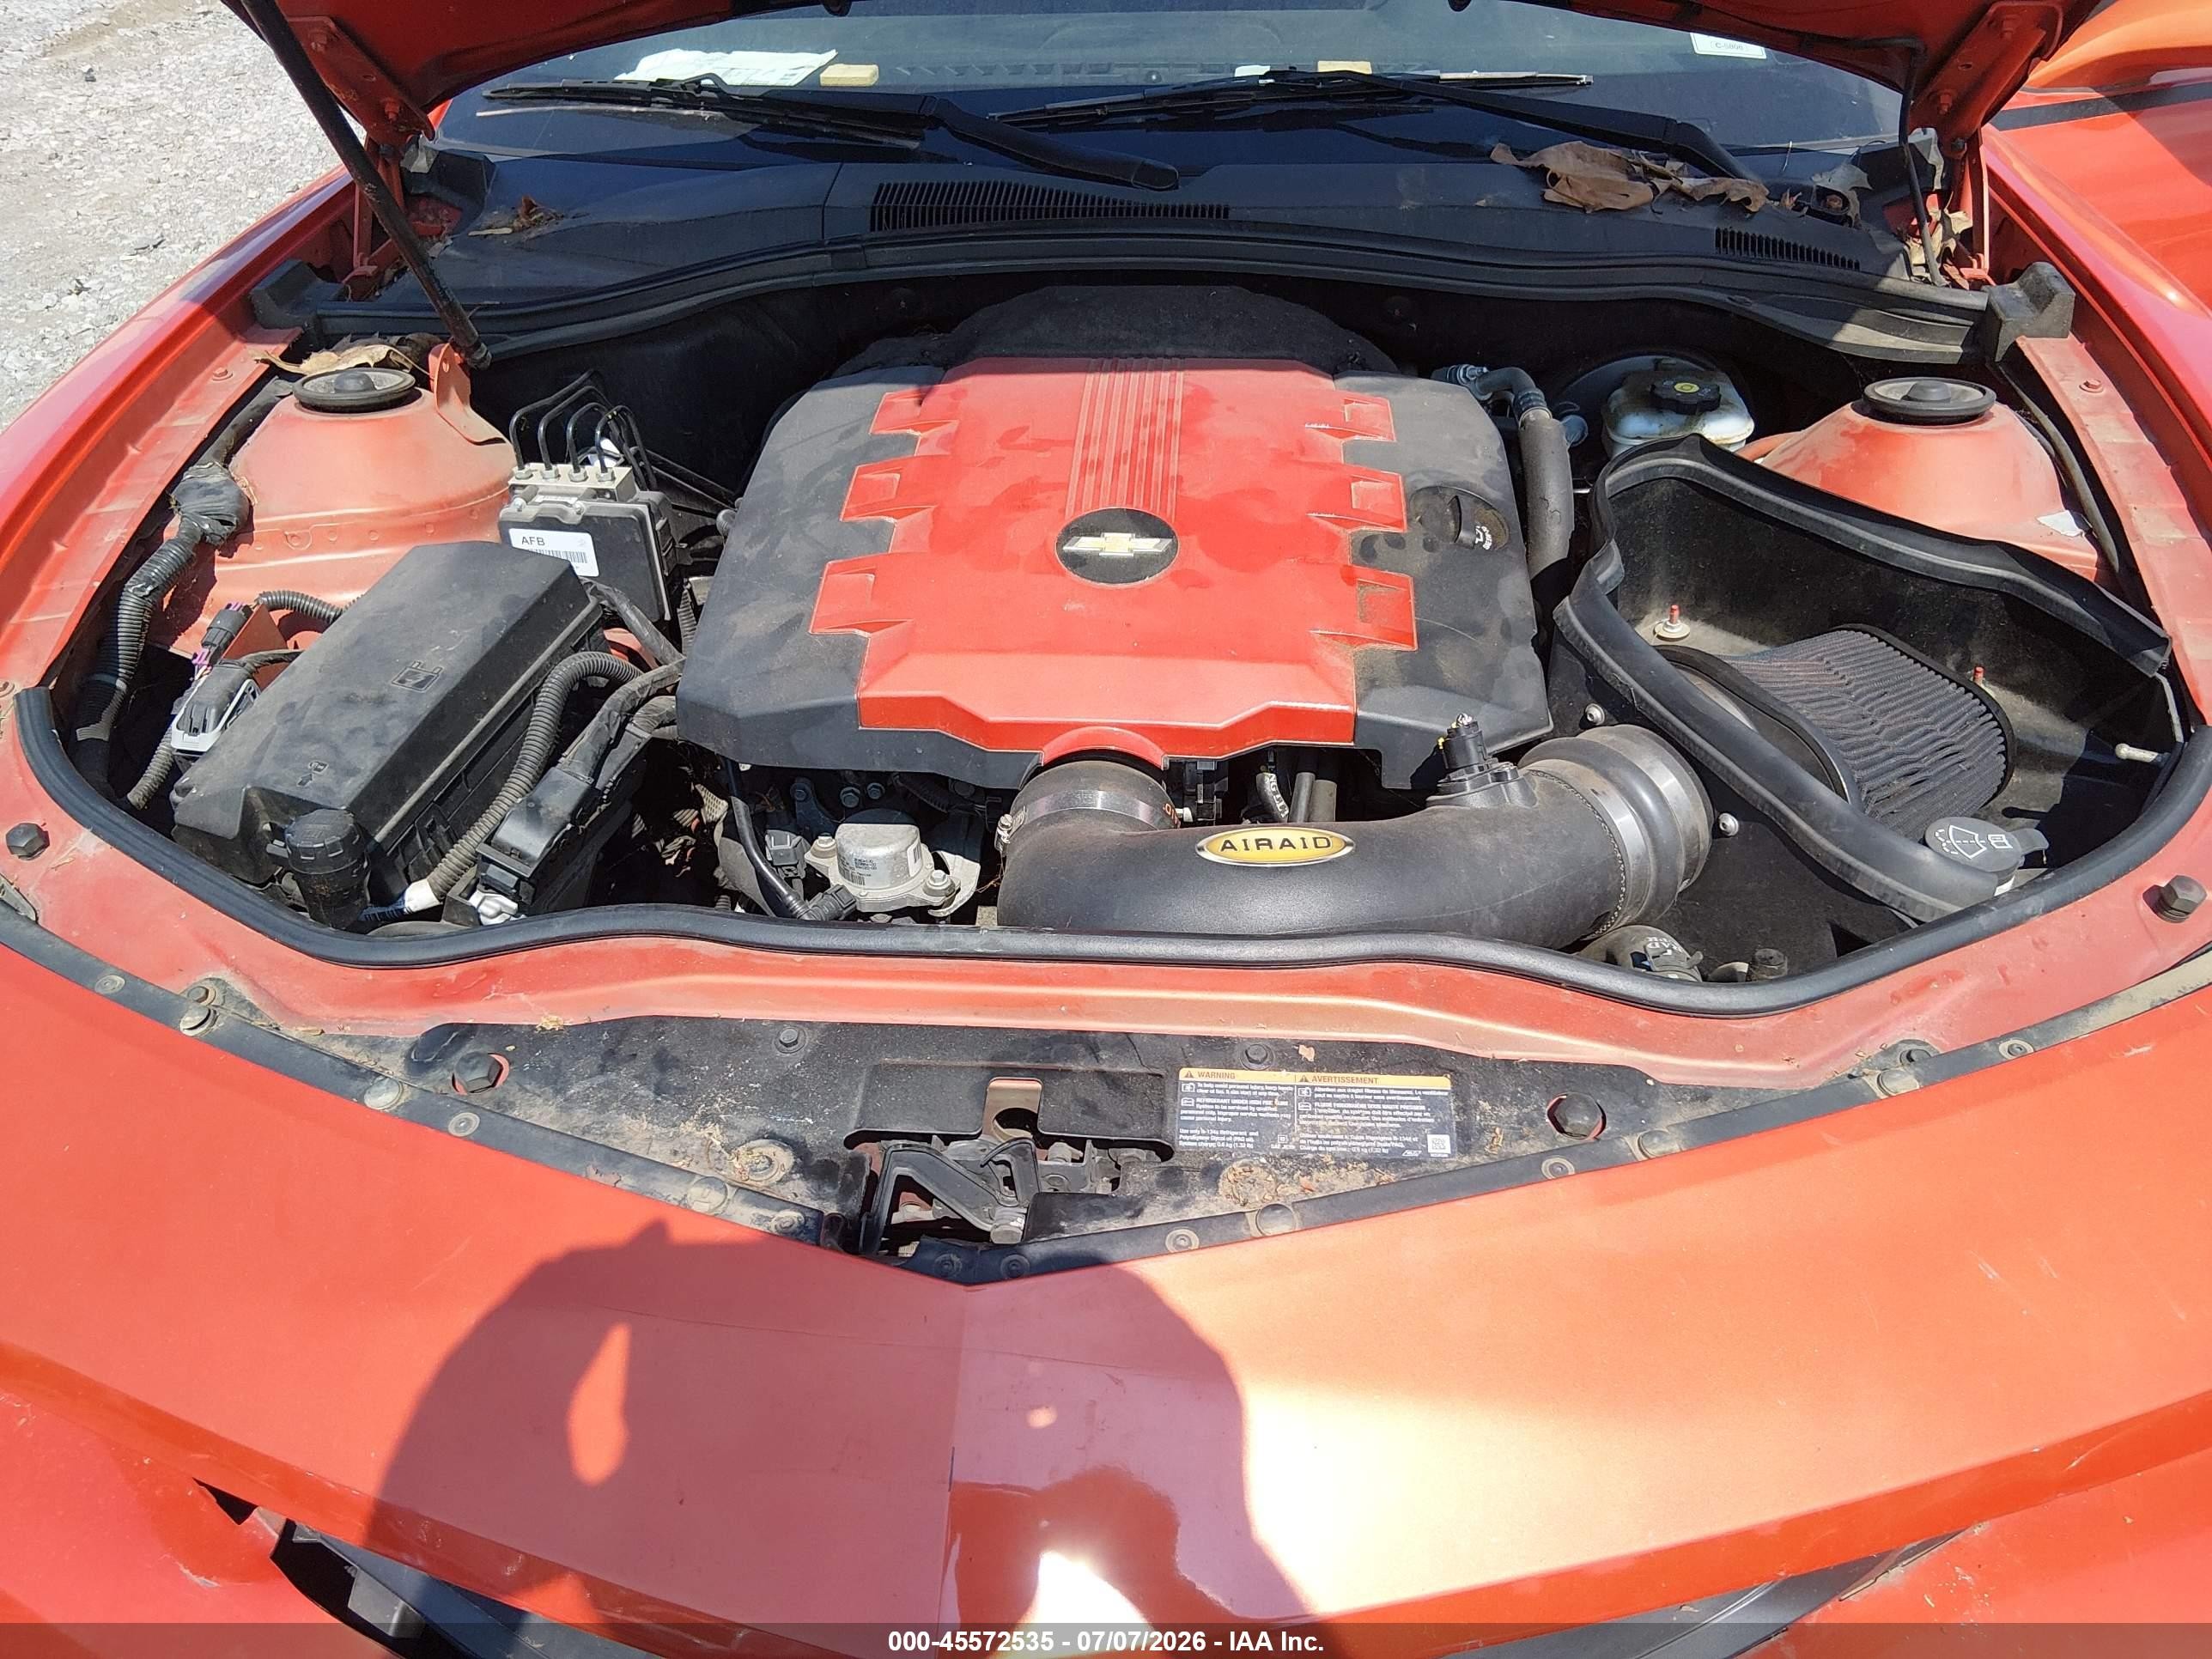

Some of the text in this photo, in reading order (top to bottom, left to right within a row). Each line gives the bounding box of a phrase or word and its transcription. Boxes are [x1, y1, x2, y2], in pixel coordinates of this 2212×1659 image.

[521, 536, 545, 546] AFB
[1220, 836, 1332, 852] AIRAID
[1197, 1071, 1236, 1079] WARNING
[1311, 1075, 1378, 1085] AVERTISSEMENT
